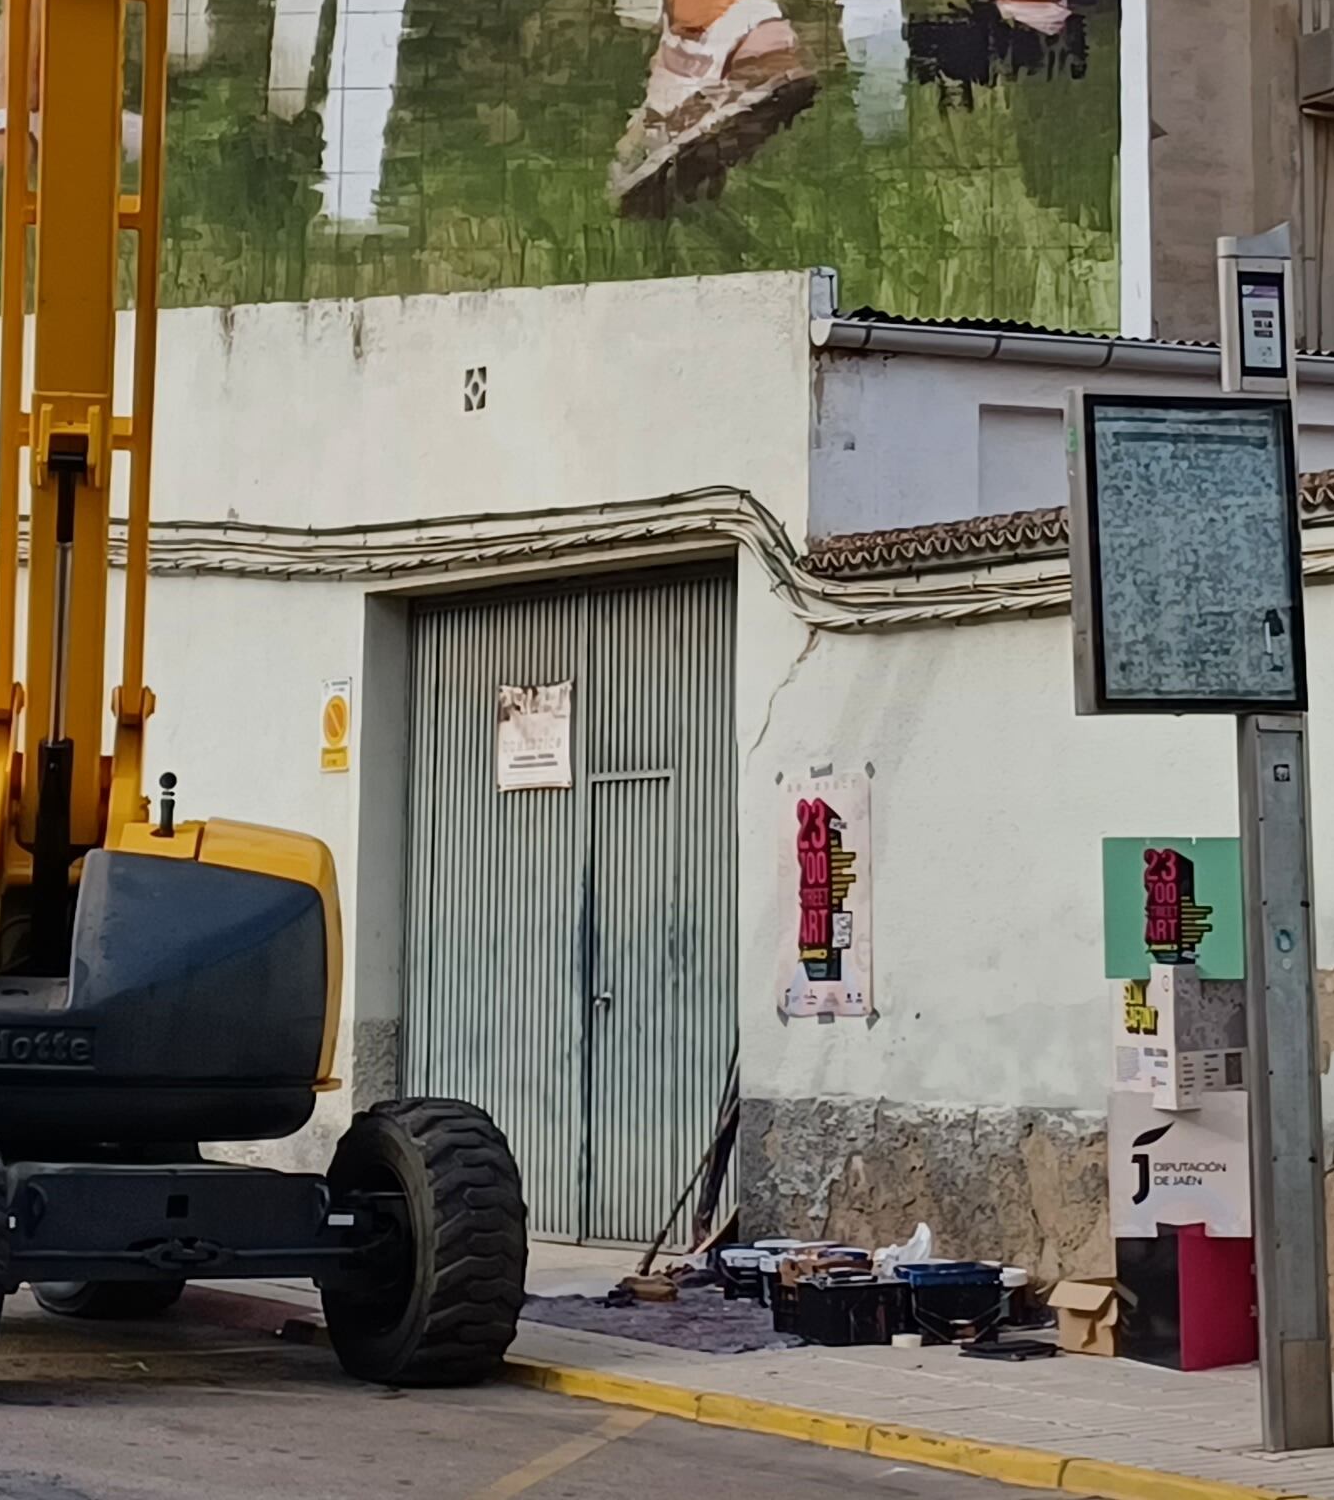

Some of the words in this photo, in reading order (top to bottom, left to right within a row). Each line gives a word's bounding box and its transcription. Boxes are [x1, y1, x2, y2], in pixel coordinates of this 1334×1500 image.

[797, 798, 826, 849] 23
[1145, 849, 1177, 881] 23
[1154, 1175, 1169, 1186] DE
